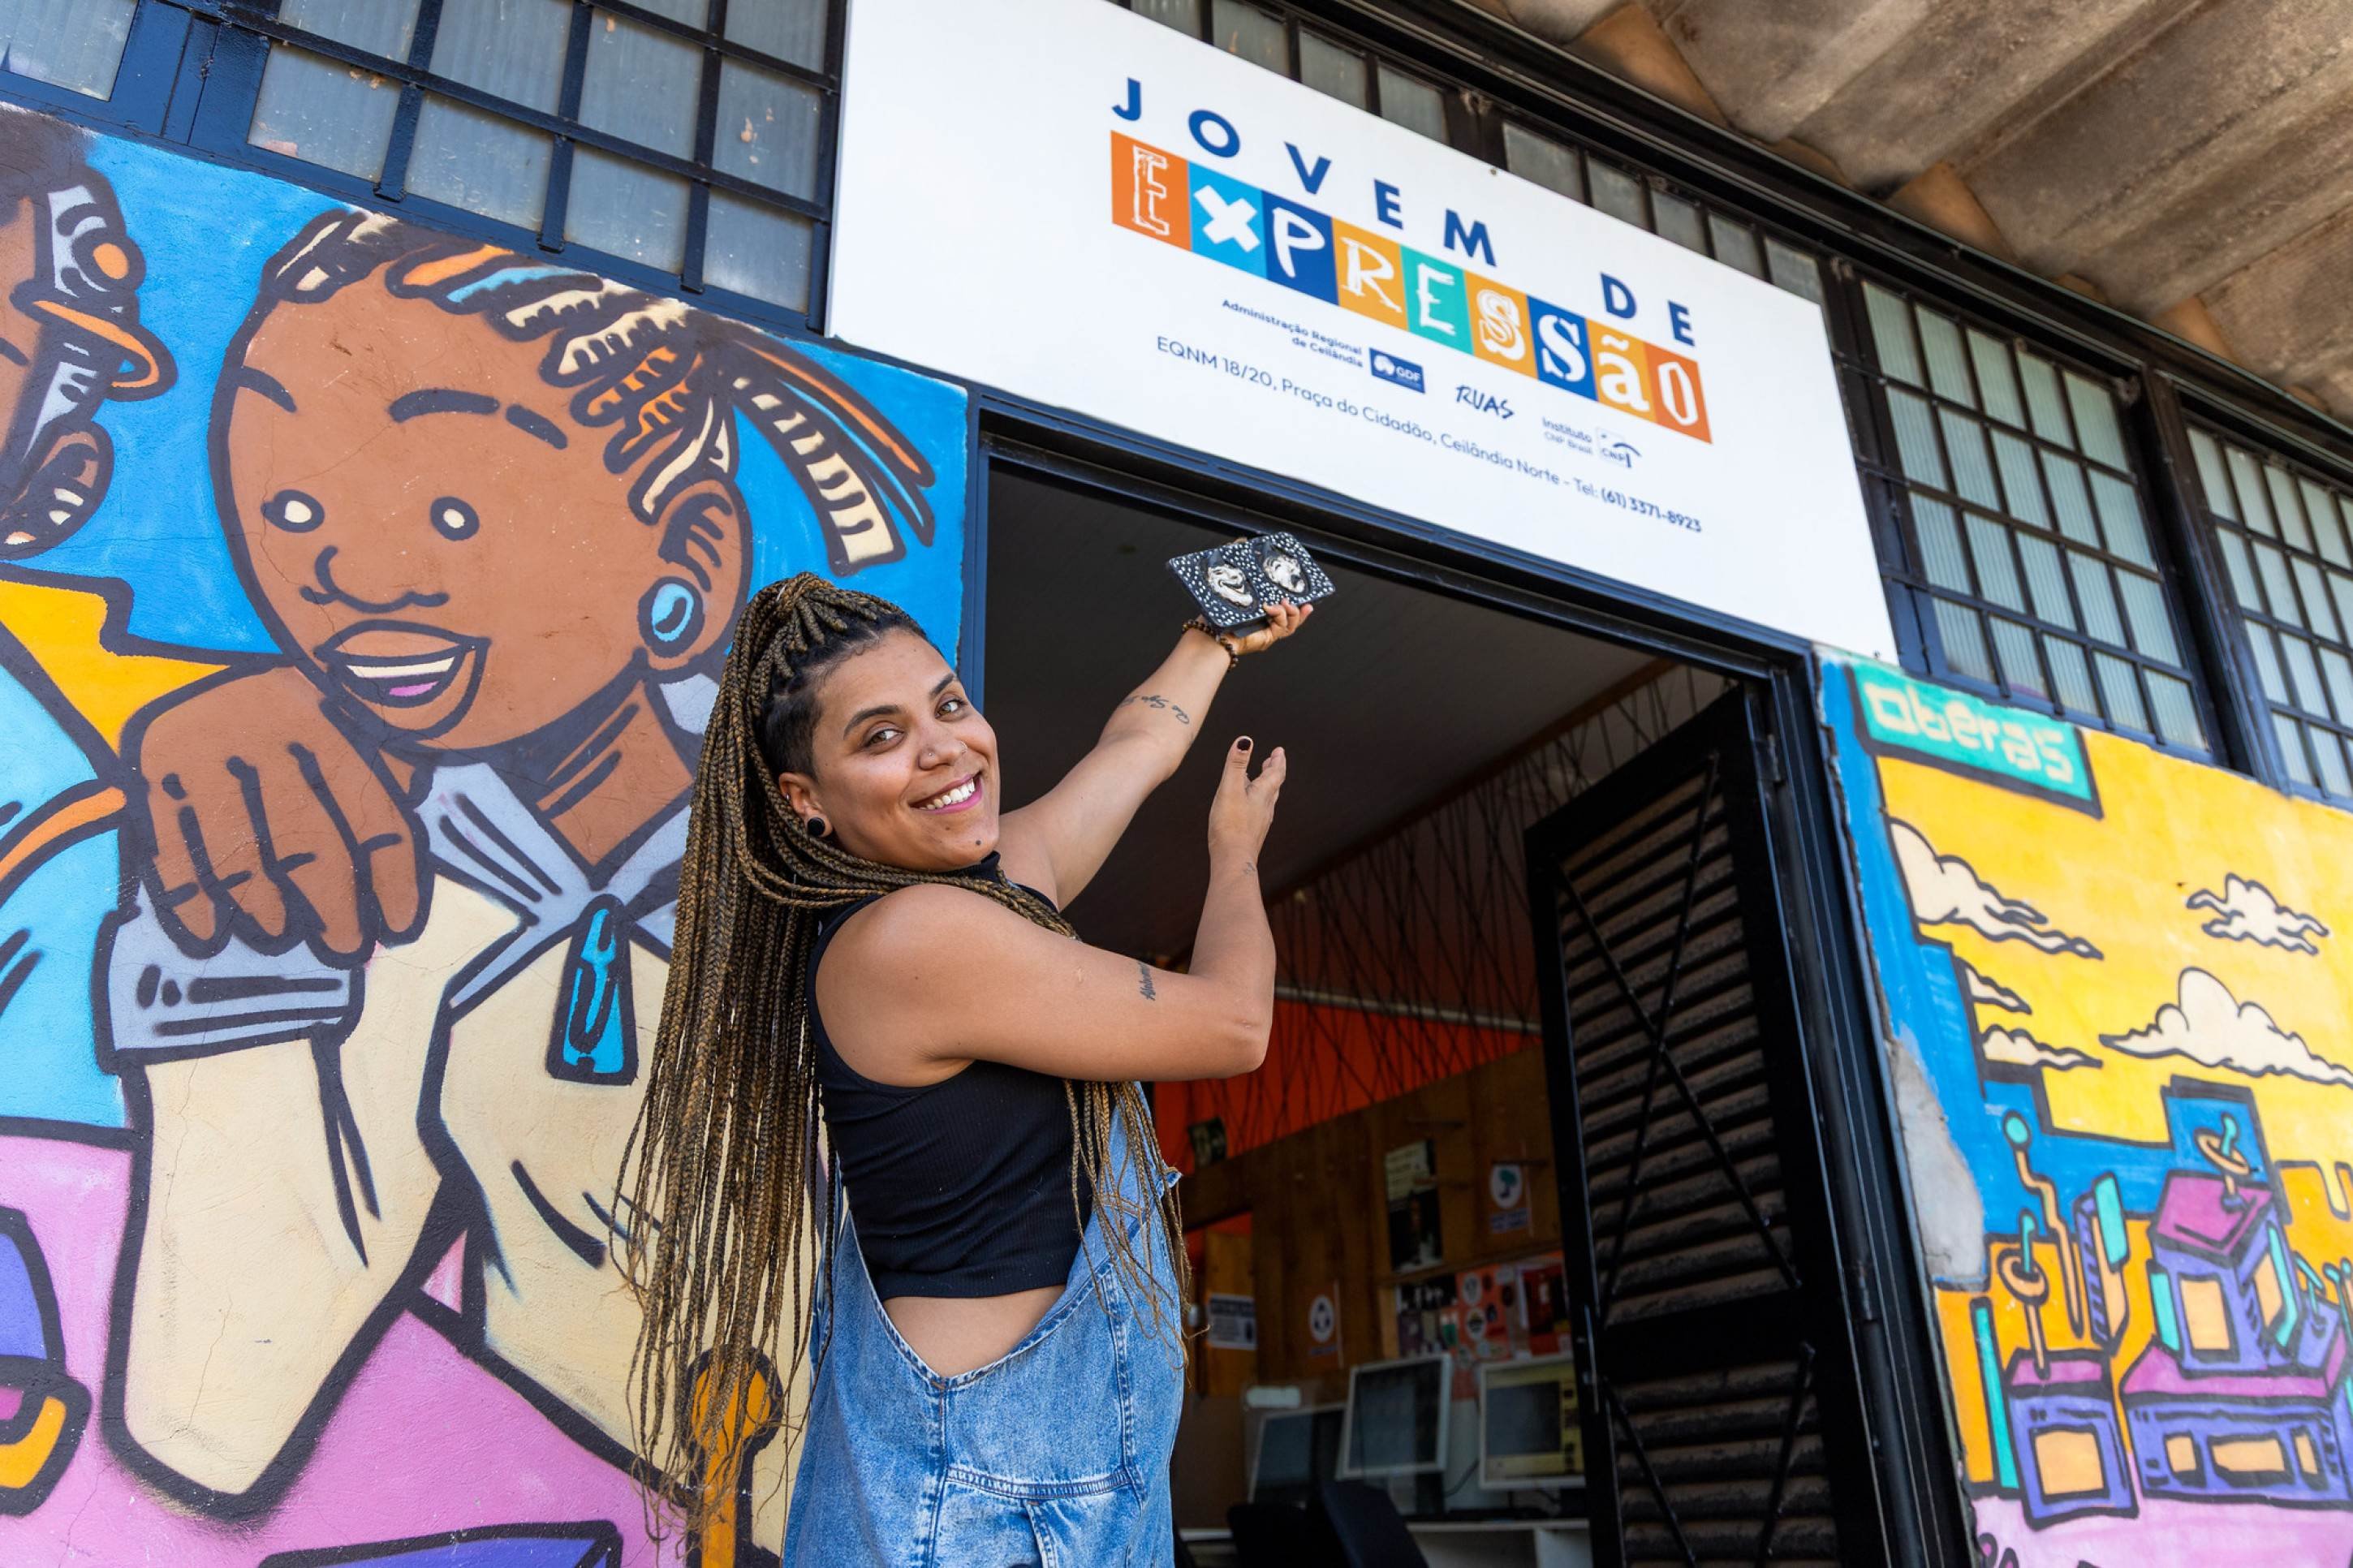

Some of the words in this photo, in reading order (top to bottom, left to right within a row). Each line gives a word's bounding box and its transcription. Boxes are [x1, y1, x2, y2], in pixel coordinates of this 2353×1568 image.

[1112, 77, 1497, 268] JOVEM
[1601, 273, 1696, 347] DE
[1222, 299, 1309, 337] Administração
[1311, 329, 1363, 355] Regional
[1291, 337, 1308, 347] de
[1309, 340, 1364, 368] Ceilândia
[1395, 366, 1420, 381] GDF
[1455, 384, 1515, 420] RUAS
[1157, 336, 1217, 369] EQNM
[1222, 357, 1277, 390] 18/20,
[1282, 378, 1333, 407] Praça
[1337, 398, 1359, 416] do
[1363, 407, 1437, 445] Cidadão,
[1441, 433, 1514, 469] Ceilândia
[1516, 459, 1560, 486] Norte
[1573, 477, 1598, 497] Tel:
[1601, 488, 1627, 510] (61)
[1629, 496, 1702, 534] 3371-8923
[1542, 417, 1592, 443] Instituto
